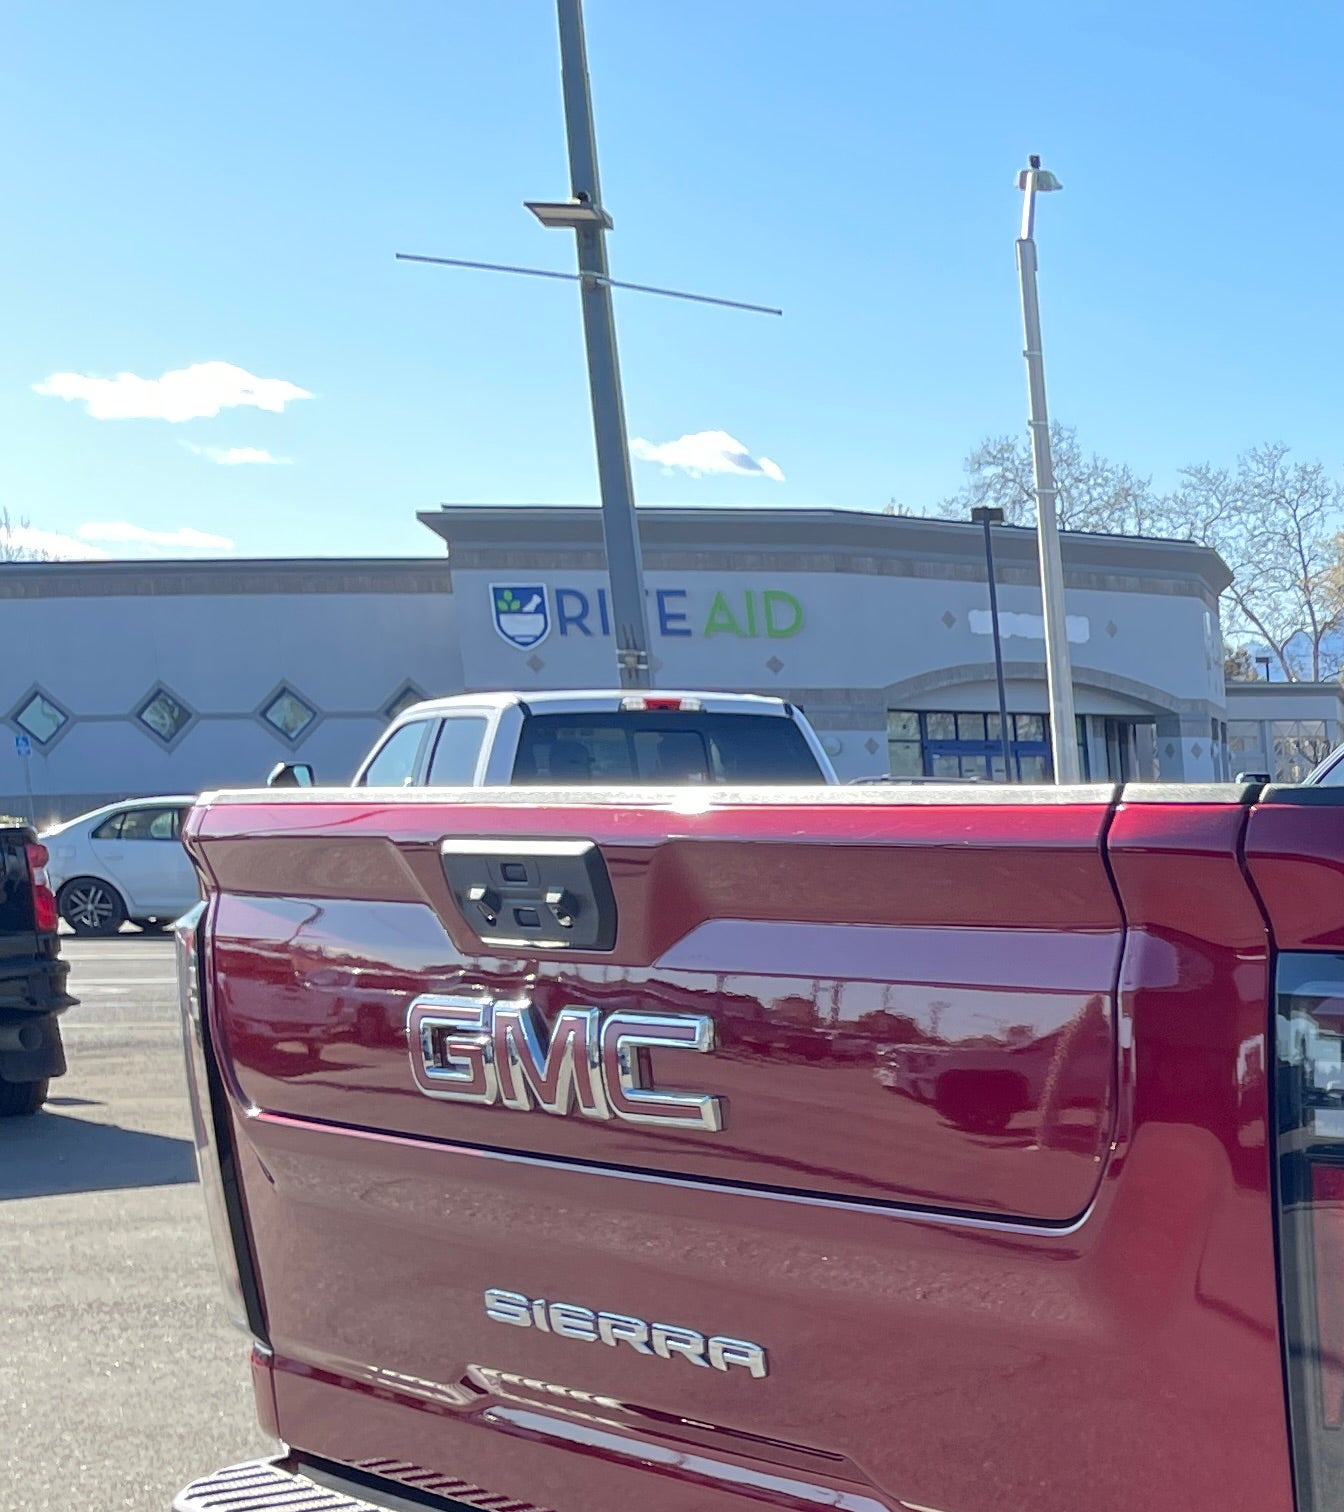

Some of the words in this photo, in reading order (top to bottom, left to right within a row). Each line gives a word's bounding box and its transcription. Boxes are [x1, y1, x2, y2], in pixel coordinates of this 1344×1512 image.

[555, 588, 692, 637] RIE
[703, 589, 804, 638] AID
[406, 994, 729, 1132] GMC
[484, 1288, 769, 1378] SIERRA
